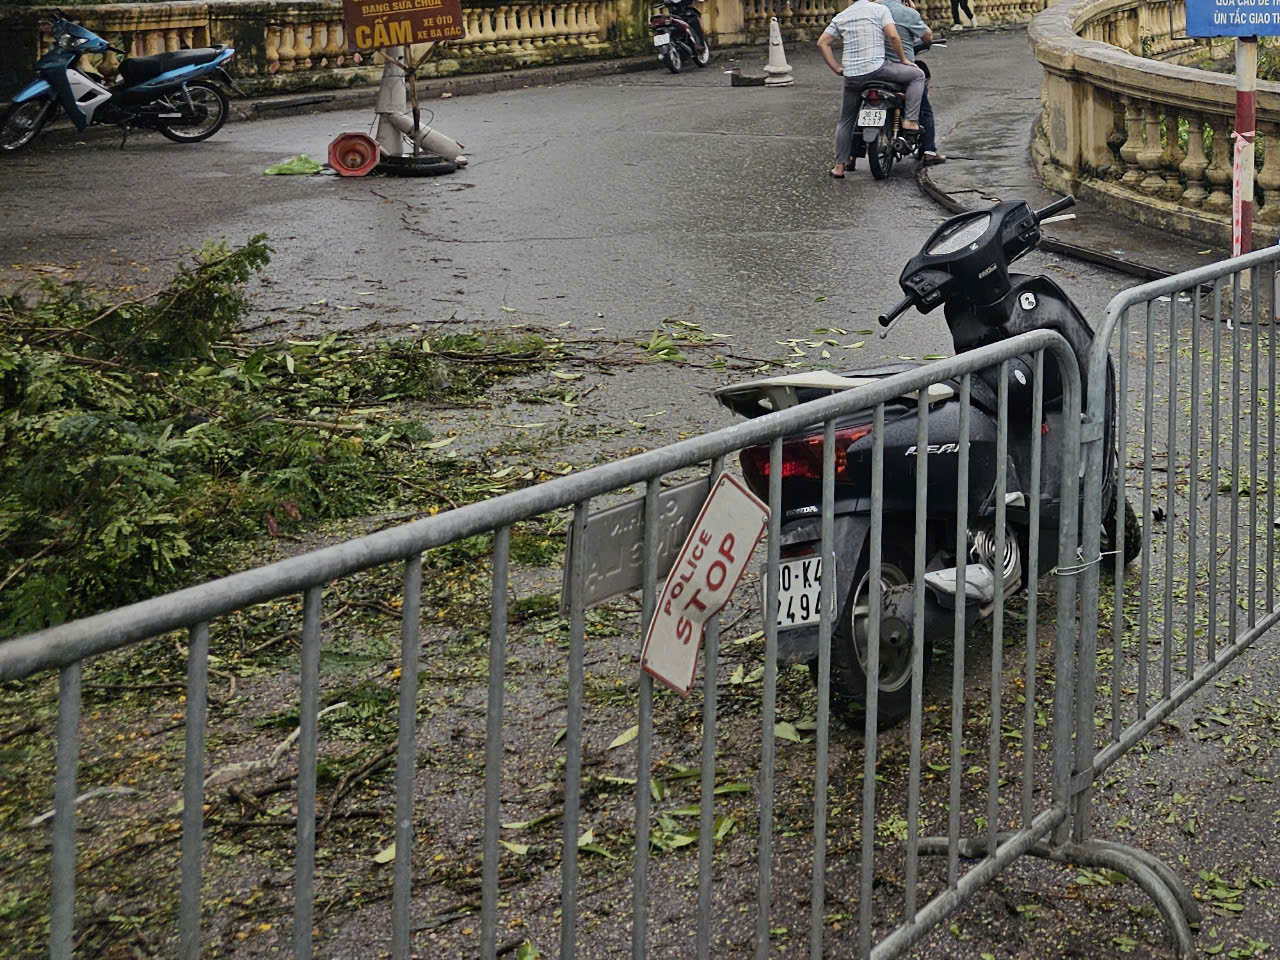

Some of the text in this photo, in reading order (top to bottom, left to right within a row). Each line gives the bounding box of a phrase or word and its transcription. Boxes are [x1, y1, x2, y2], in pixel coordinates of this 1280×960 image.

[362, 3, 390, 14] ĐANG
[1213, 10, 1228, 24] ÙN
[1229, 8, 1248, 24] TẮC
[1249, 12, 1271, 24] GIAO
[355, 16, 413, 49] CẤM
[417, 30, 429, 40] XE
[430, 29, 443, 38] BA
[423, 18, 435, 27] XE
[664, 528, 712, 617] POLICE
[779, 558, 822, 592] 0-K4
[676, 532, 736, 645] STOP
